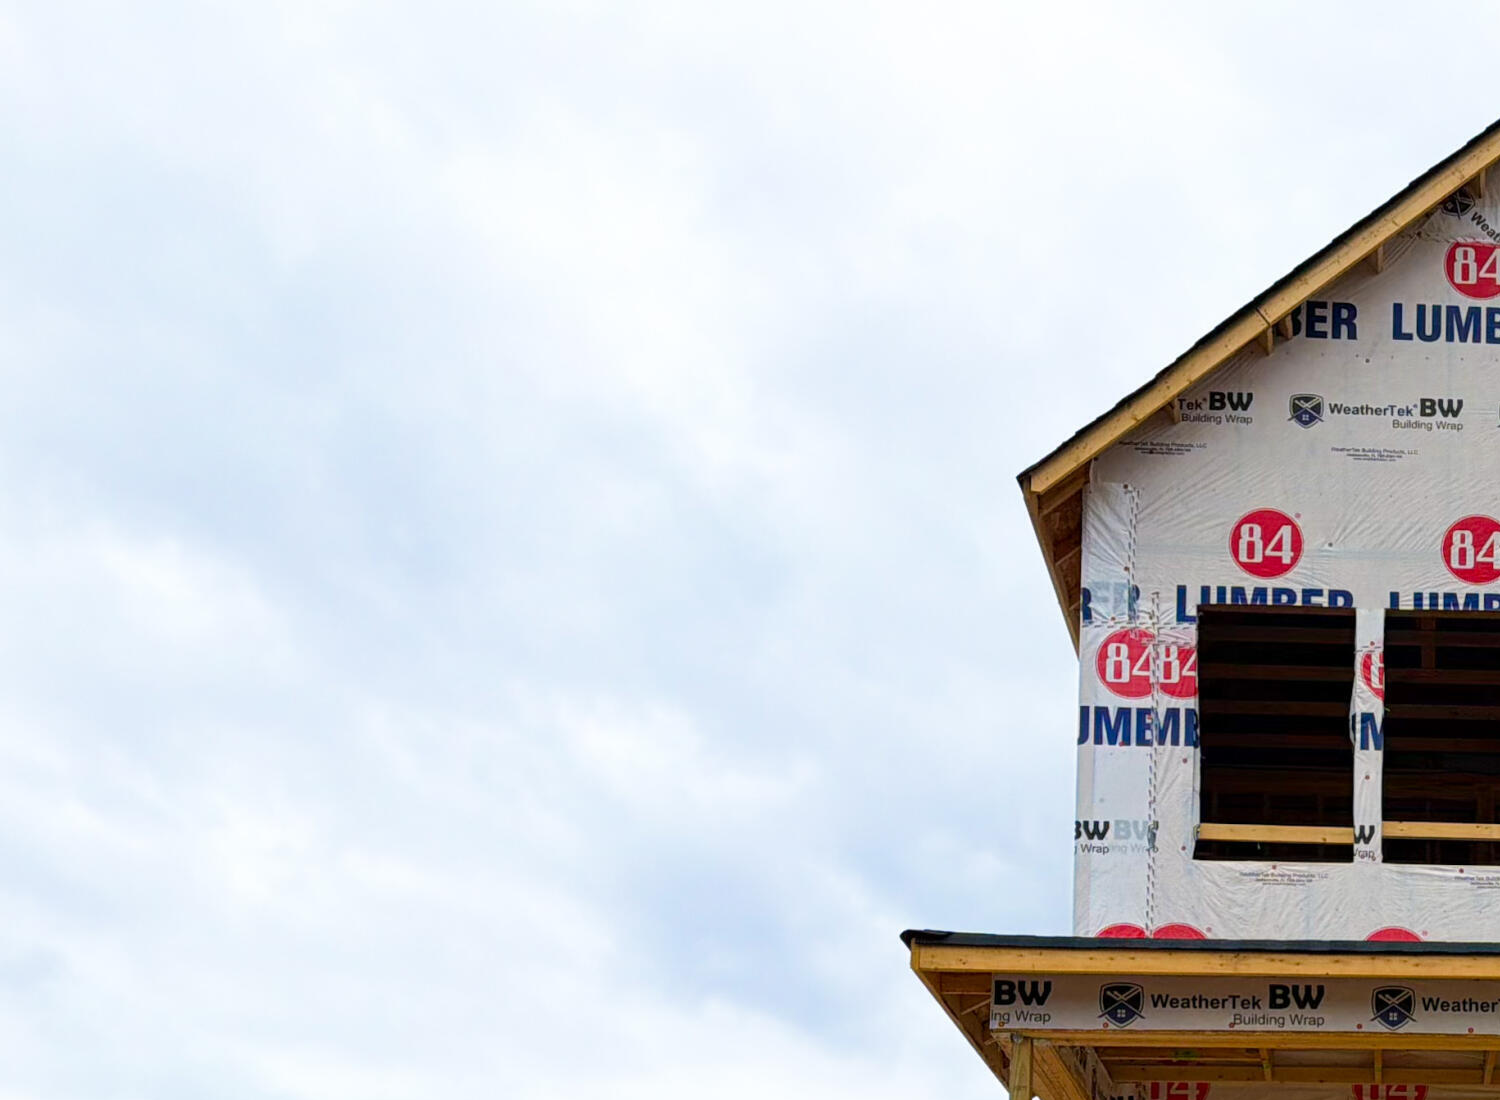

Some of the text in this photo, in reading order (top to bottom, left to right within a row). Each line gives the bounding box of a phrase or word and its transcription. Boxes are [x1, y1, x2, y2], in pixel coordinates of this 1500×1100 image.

[1209, 391, 1253, 411] BW
[1329, 398, 1463, 418] WeatherTek BW
[1182, 413, 1253, 425] Building Wrap
[1392, 419, 1463, 431] Building Wrap
[1239, 523, 1294, 564] 84
[994, 980, 1051, 1006] BW
[1151, 984, 1325, 1011] WeatherTek BW
[1015, 1011, 1051, 1025] Wrap
[1233, 1013, 1325, 1028] Building Wrap
